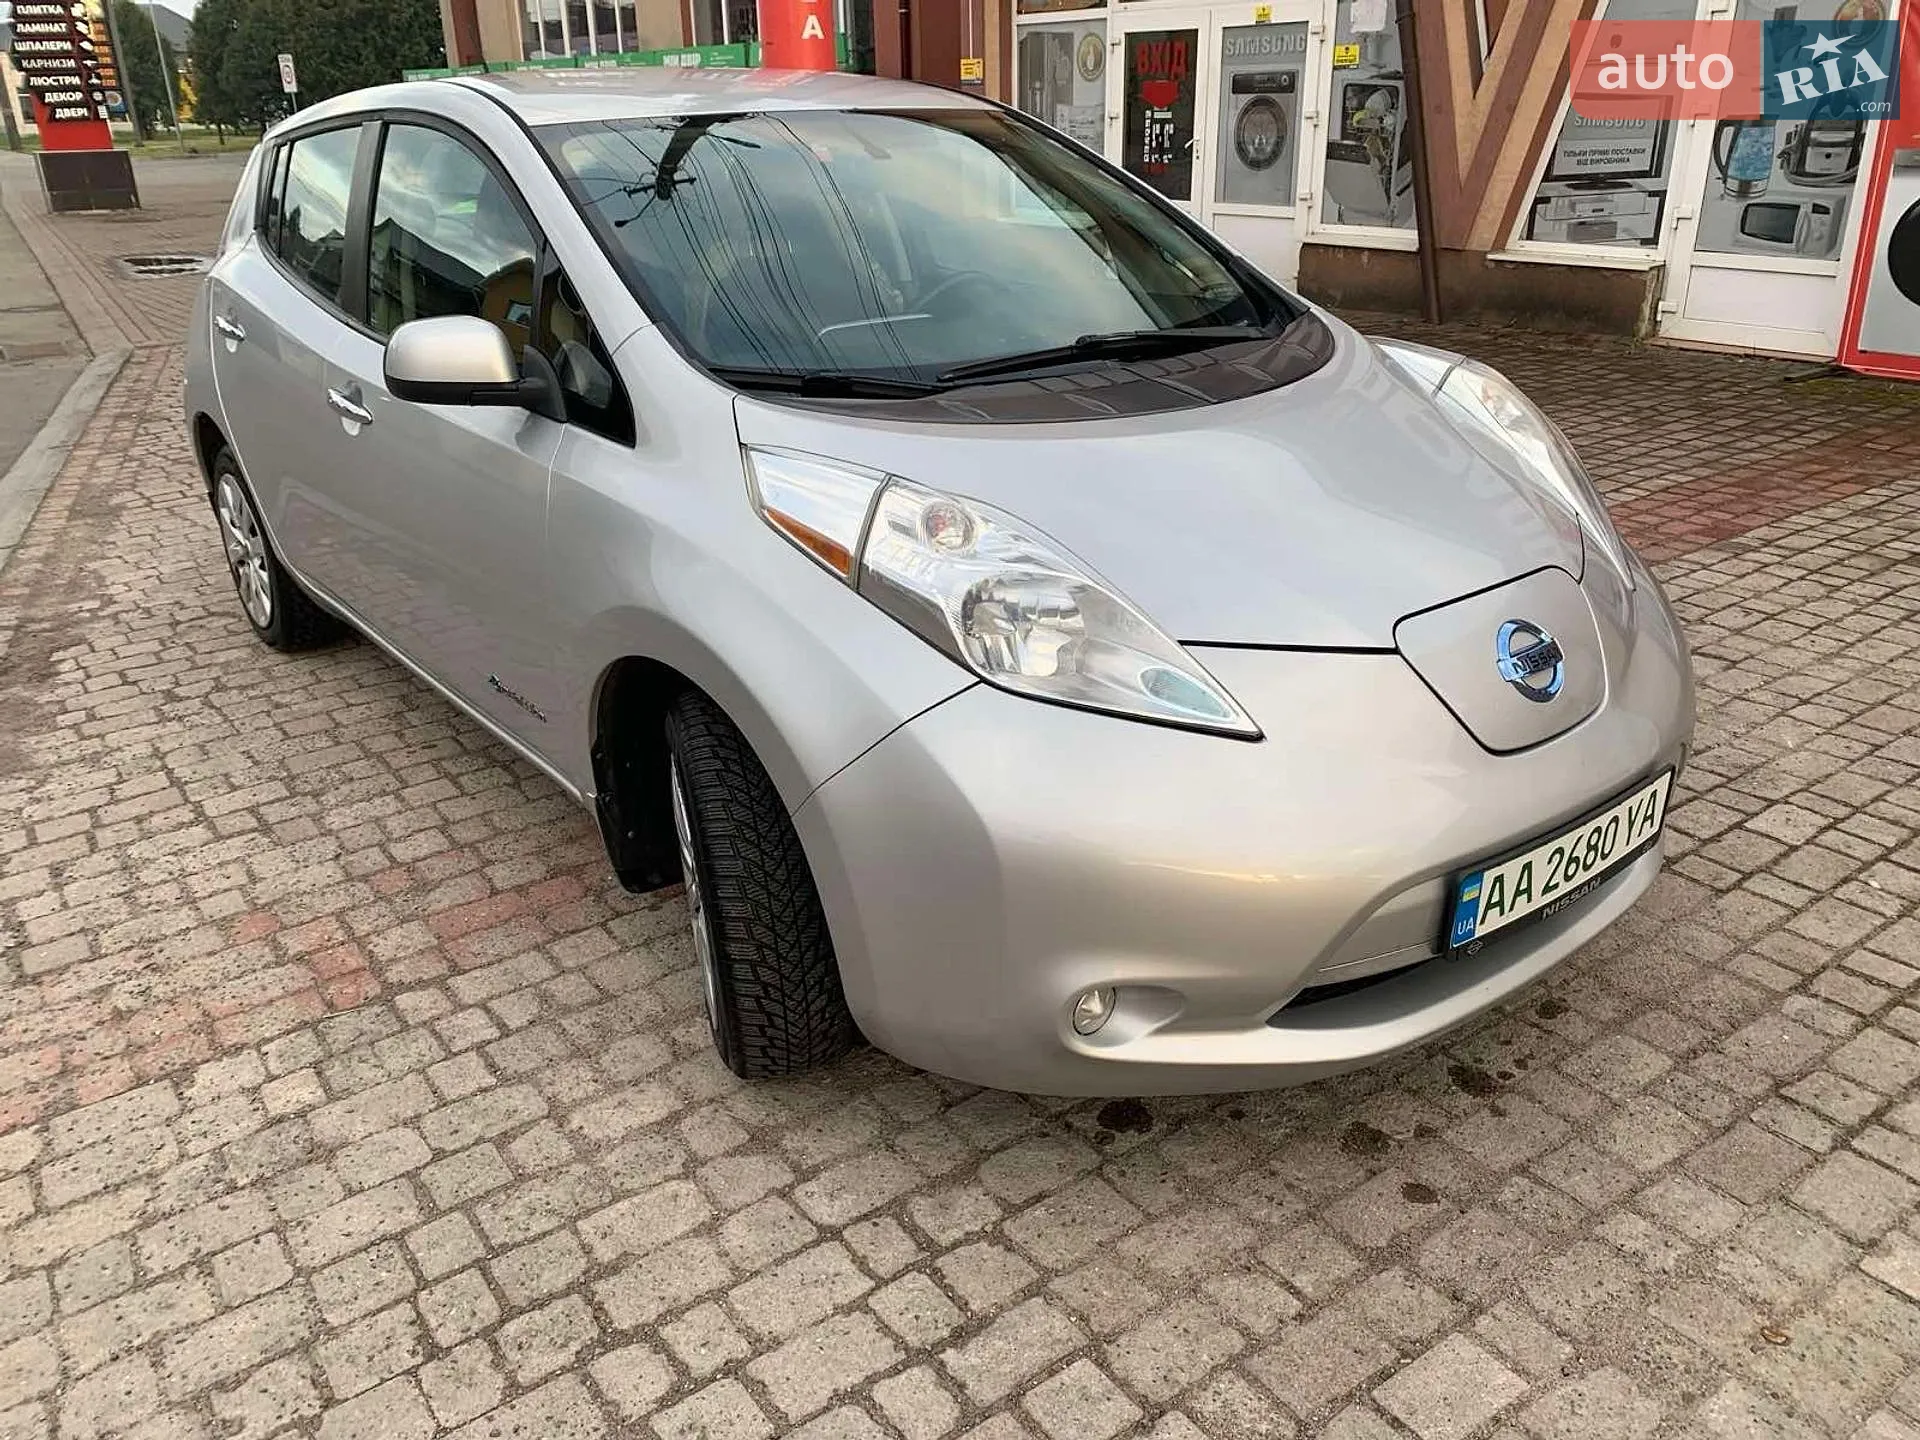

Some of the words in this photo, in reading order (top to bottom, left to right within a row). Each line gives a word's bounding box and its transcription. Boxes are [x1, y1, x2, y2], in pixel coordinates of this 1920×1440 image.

[16, 4, 65, 15] ПЛИТКА
[16, 22, 67, 32] ЛАМІНАТ
[14, 40, 72, 51] ШПАЛЕРИ
[1225, 33, 1306, 57] SAMSUNG
[21, 58, 76, 69] КАРНИЗИ
[1135, 40, 1189, 80] ВХІД
[29, 75, 81, 86] ЛЮСТРИ
[44, 90, 84, 103] ДЕКОР
[54, 106, 89, 119] ДВЕРІ
[1511, 642, 1561, 675] NISSA
[1479, 860, 1533, 927] AA
[1541, 815, 1620, 898] 2680
[1626, 788, 1659, 846] YA
[1541, 877, 1602, 920] NISSAN
[1456, 916, 1475, 936] UA
